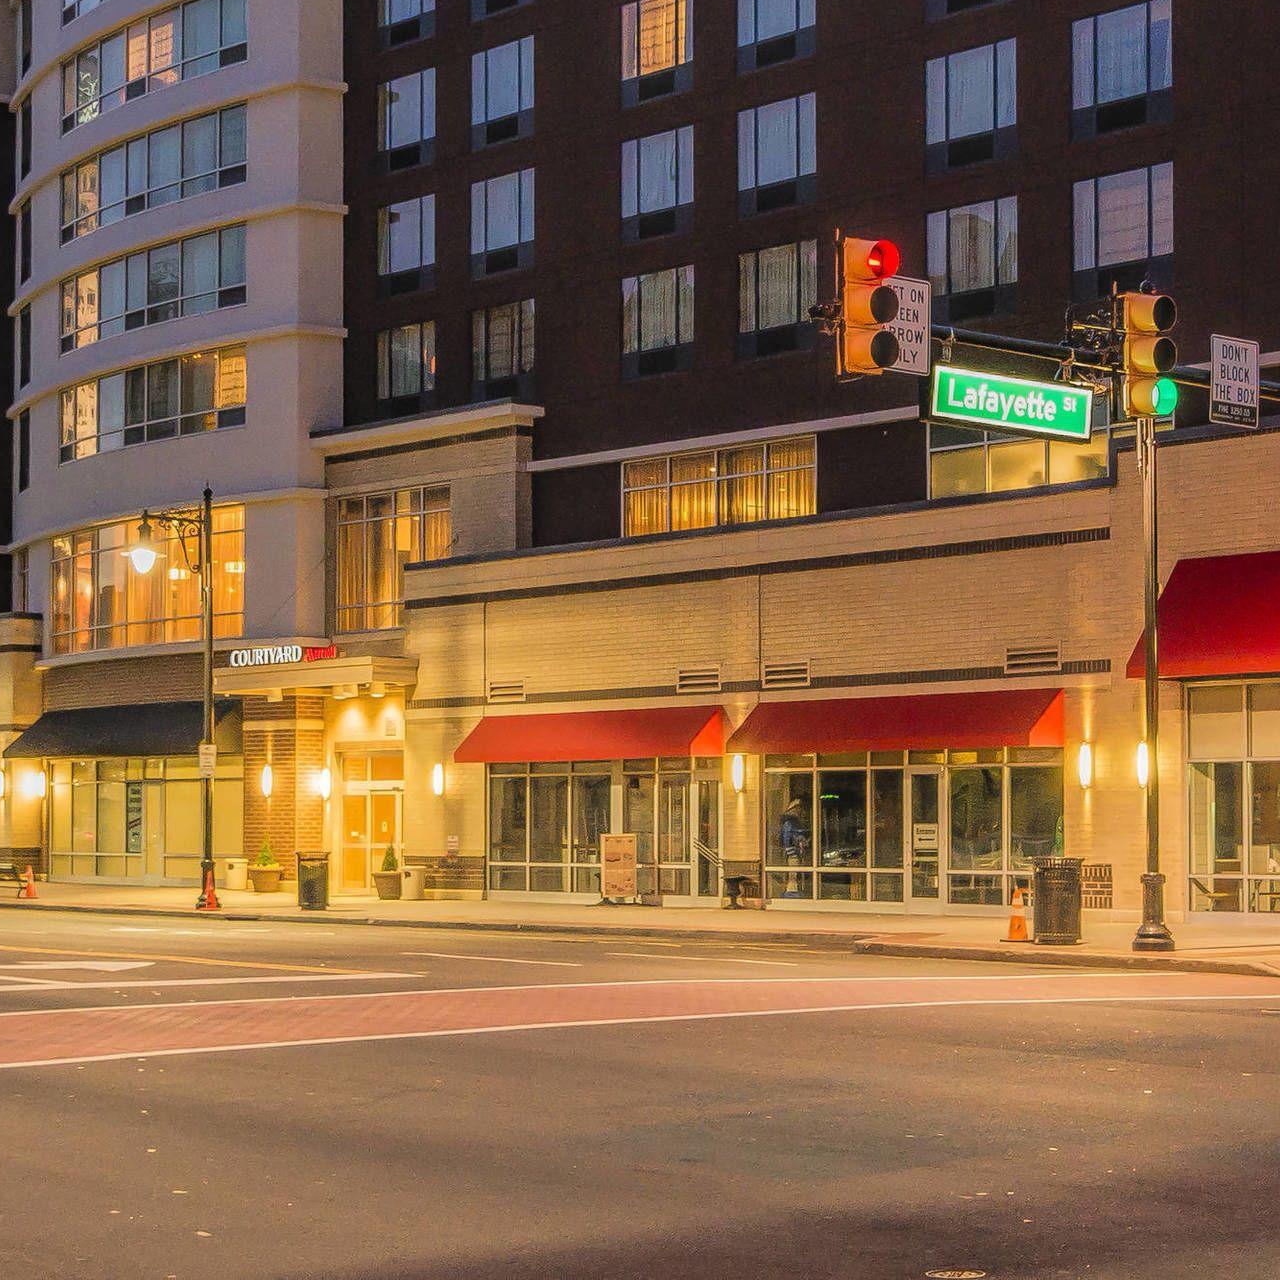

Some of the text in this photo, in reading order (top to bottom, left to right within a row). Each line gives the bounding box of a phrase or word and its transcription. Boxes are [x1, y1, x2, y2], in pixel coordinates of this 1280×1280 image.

[910, 288, 925, 304] ON
[1222, 344, 1248, 362] DON'T
[1220, 363, 1250, 385] BLOCK
[948, 377, 1057, 421] Lafayette
[1214, 382, 1255, 405] THE BOX
[230, 645, 302, 667] COURTYARD
